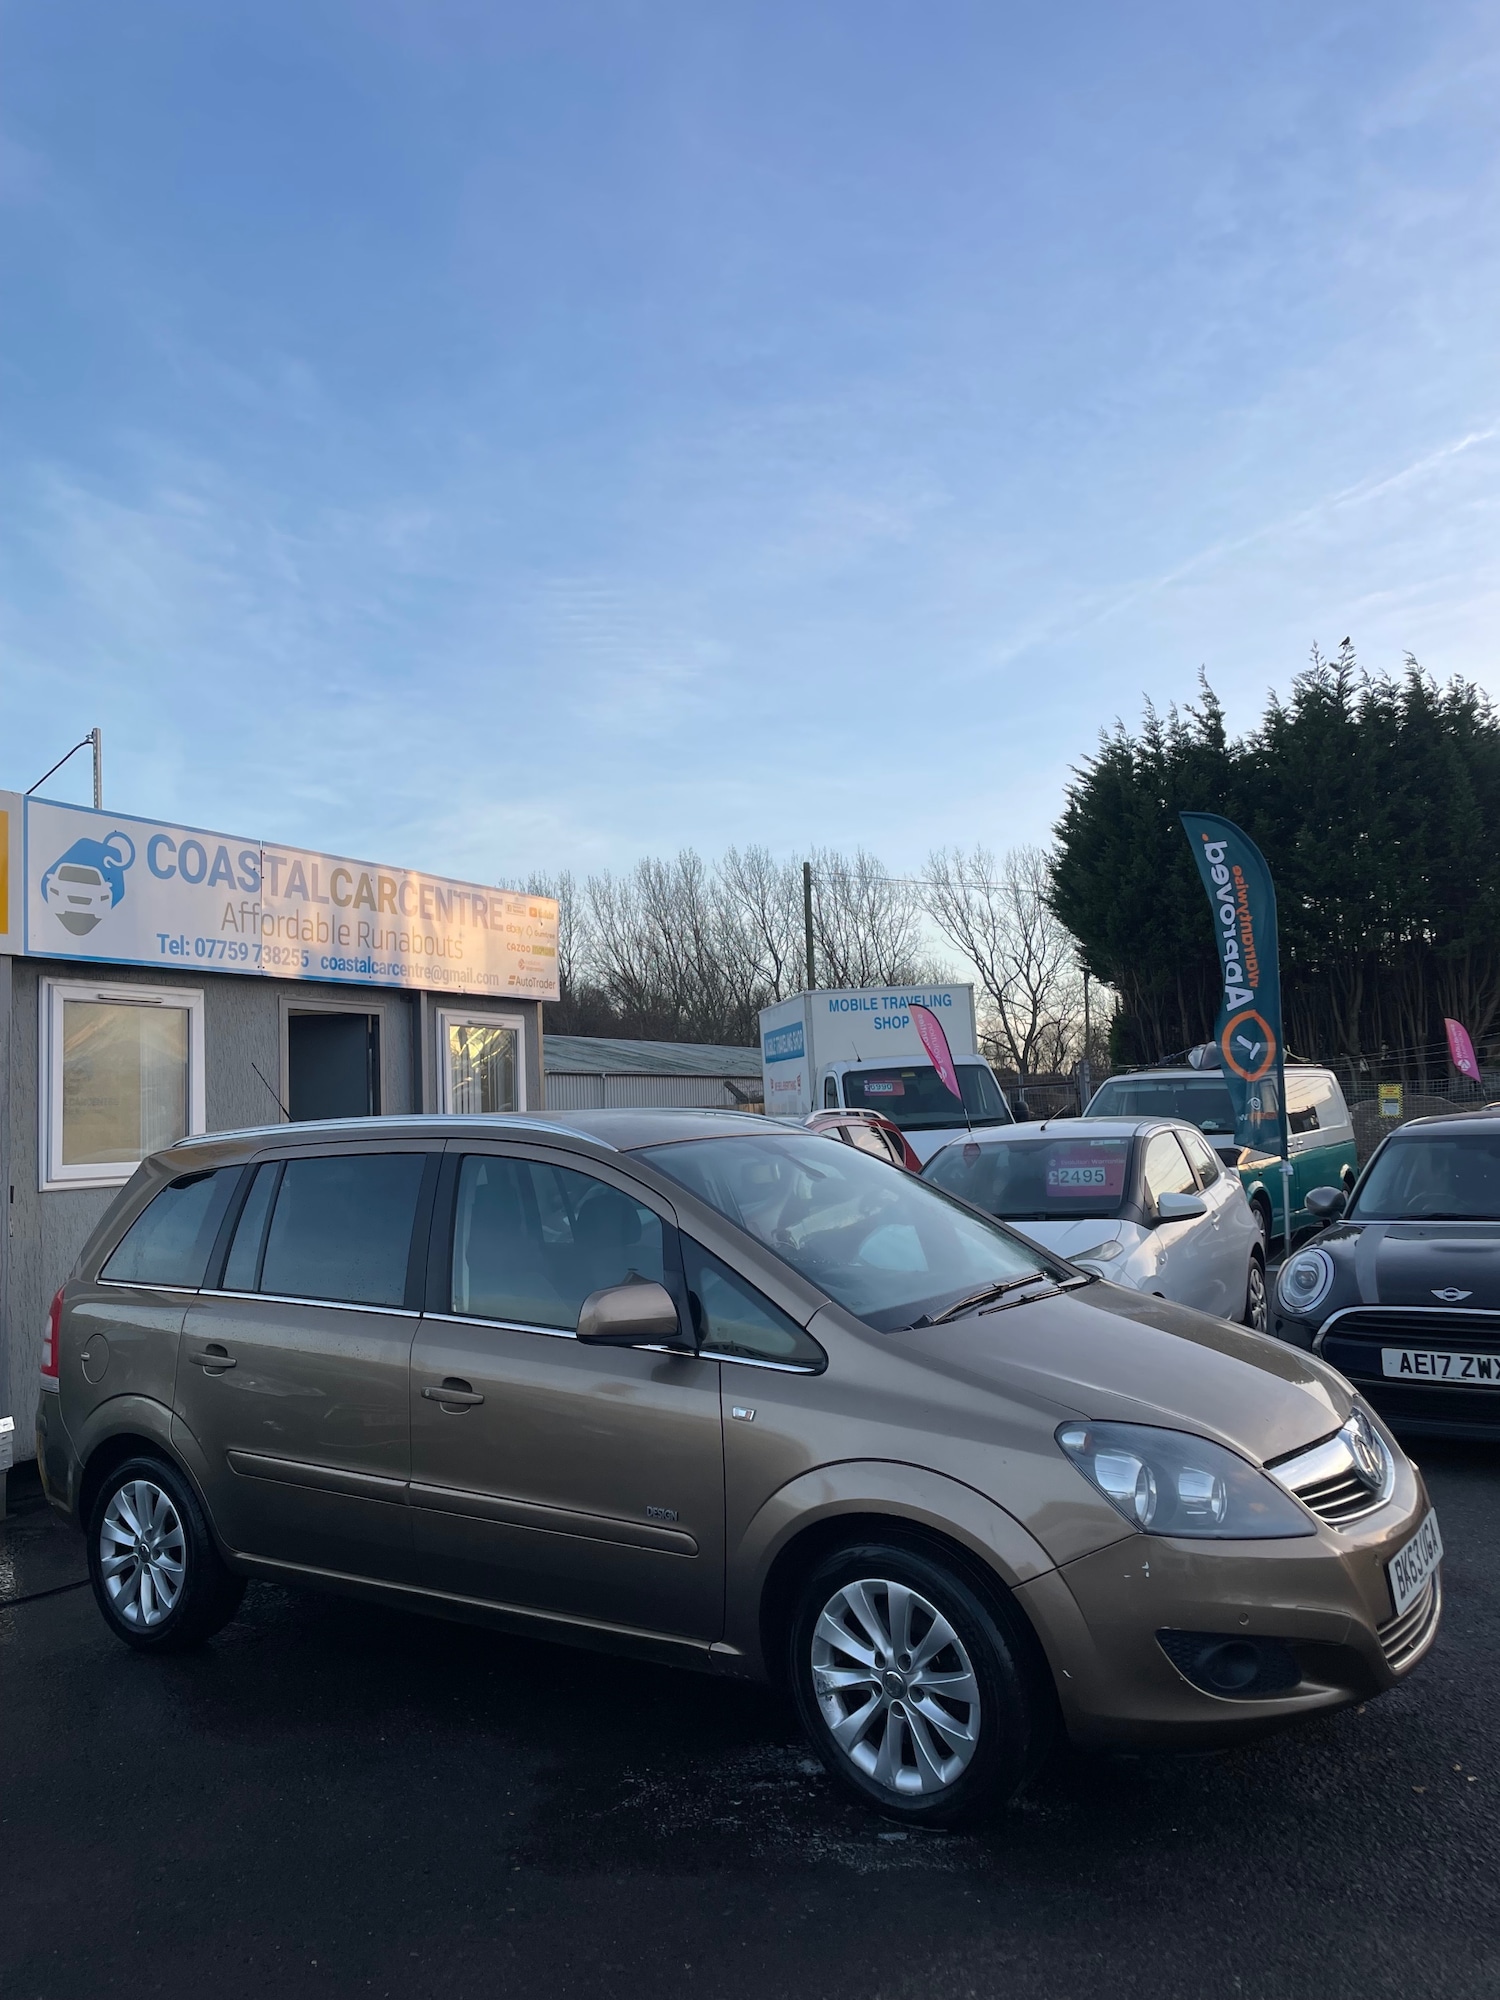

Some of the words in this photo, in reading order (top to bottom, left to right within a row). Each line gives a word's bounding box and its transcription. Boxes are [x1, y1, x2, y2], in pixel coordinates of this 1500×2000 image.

[221, 901, 350, 946] Affordable
[357, 920, 464, 960] Runabouts
[156, 933, 190, 956] Tel:
[195, 937, 249, 961] 07759
[252, 943, 310, 968] 738255
[320, 953, 500, 986] coastalcarcentre@gmail.com
[515, 975, 556, 990] AutoTrader
[829, 997, 878, 1012] MOBILE
[881, 993, 952, 1010] TRAVELING
[874, 1015, 910, 1030] SHOP
[1400, 1352, 1451, 1376] AE17
[646, 1505, 679, 1521] DESIGN
[1394, 1538, 1424, 1600] BK63
[1418, 1517, 1439, 1567] UGA
